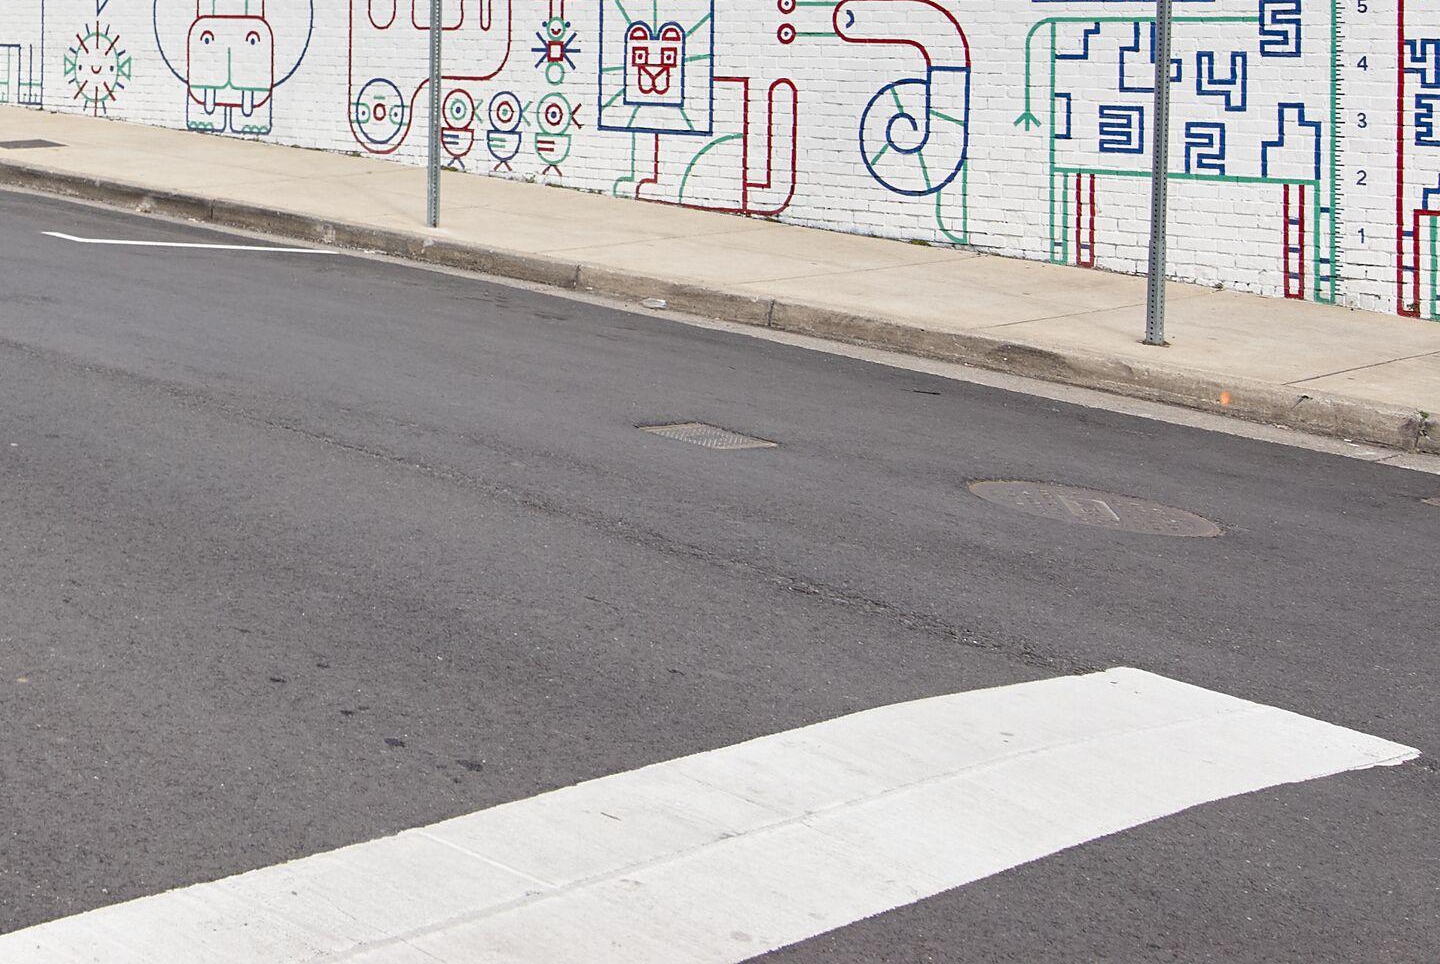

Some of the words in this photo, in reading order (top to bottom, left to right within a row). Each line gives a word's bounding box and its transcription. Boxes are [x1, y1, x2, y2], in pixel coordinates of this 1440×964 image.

[1357, 55, 1369, 71] 4
[1357, 112, 1368, 128] 3
[1356, 169, 1368, 185] 2
[1357, 228, 1365, 243] 1
